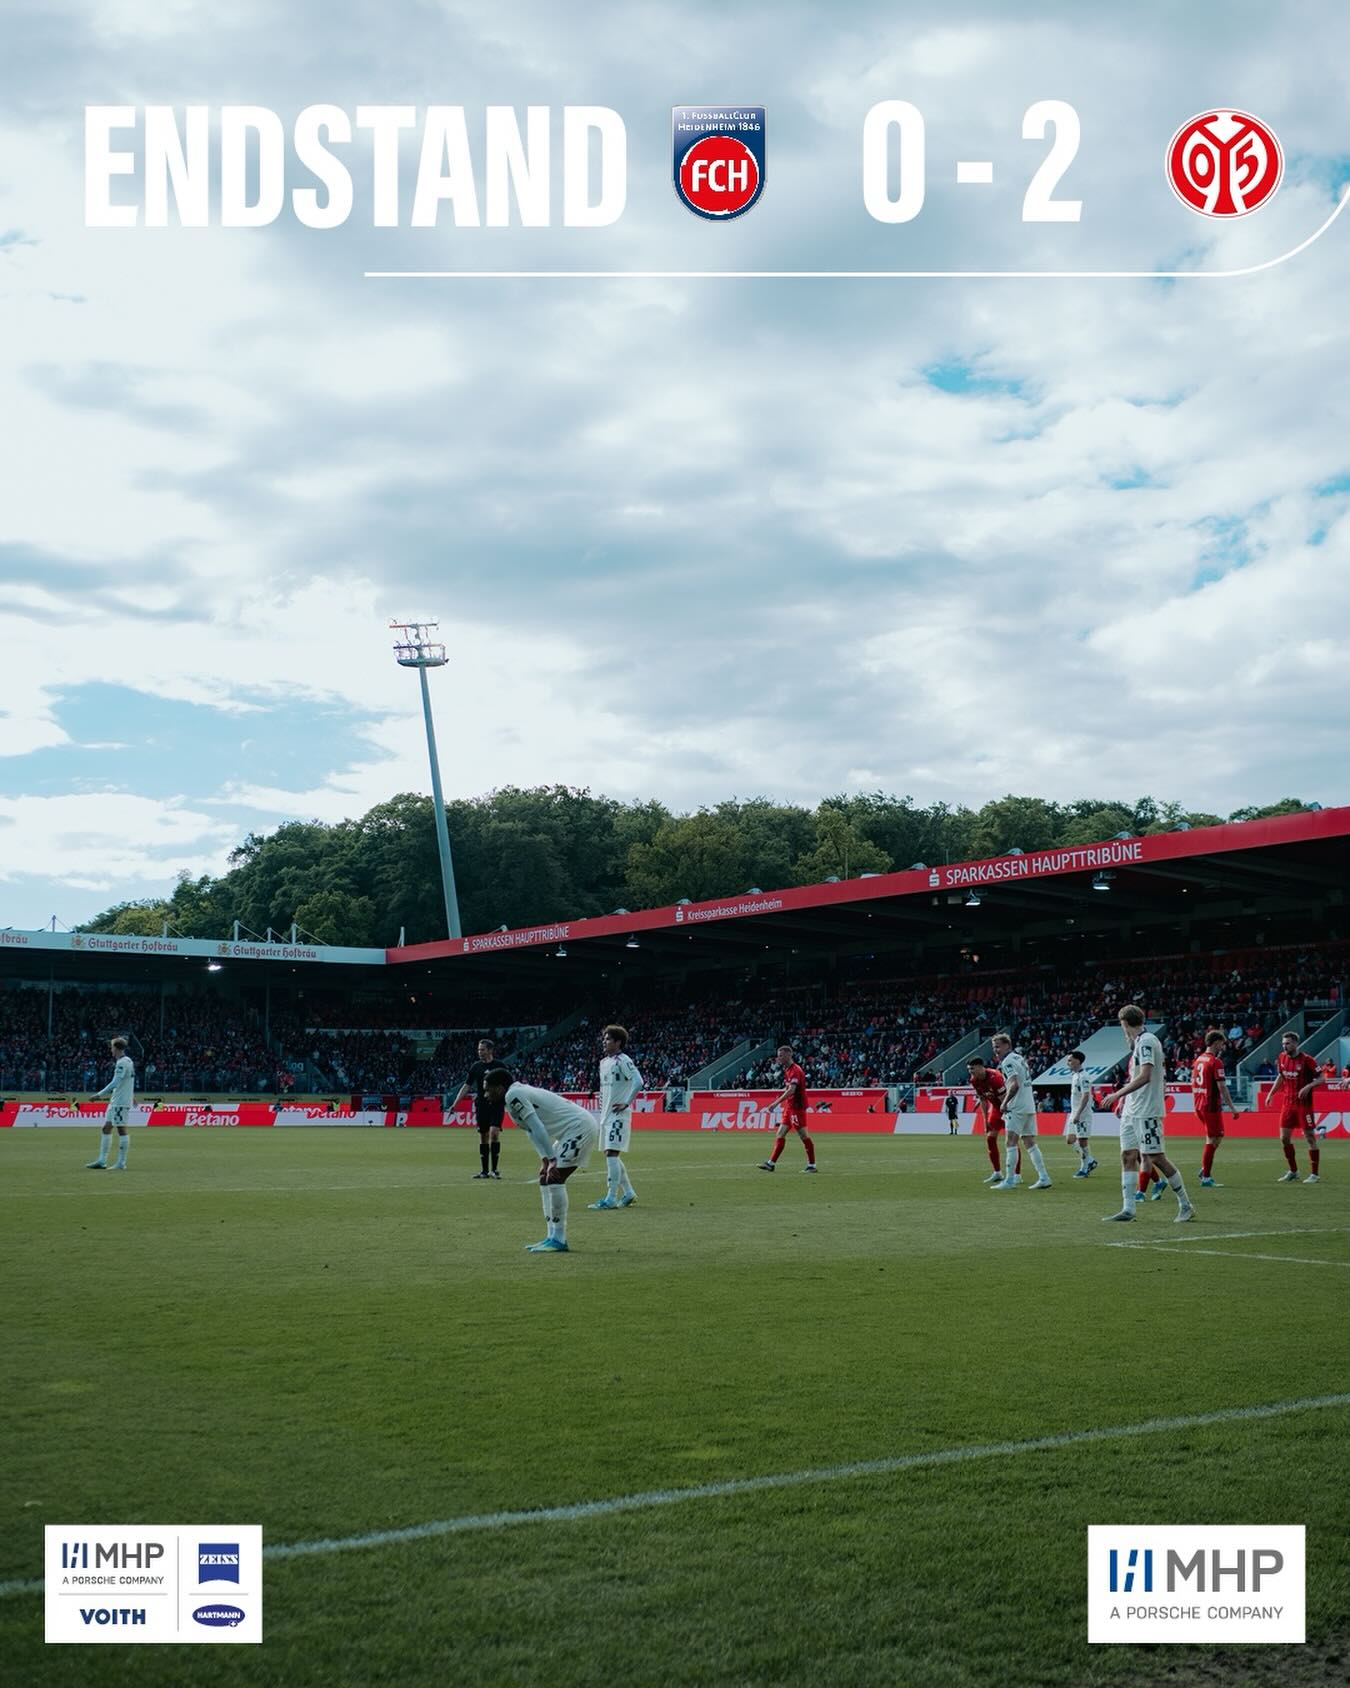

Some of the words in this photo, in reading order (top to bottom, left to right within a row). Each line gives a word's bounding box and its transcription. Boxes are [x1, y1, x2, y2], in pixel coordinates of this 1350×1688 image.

[946, 859, 1029, 885] SPARKASSEN
[1032, 842, 1143, 873] HAUPTTRIBÜNE
[687, 906, 738, 920] Kreissparkasse
[739, 898, 783, 913] Heidenheim
[88, 937, 140, 951] Stuttgarter
[141, 939, 178, 952] Hofbräu
[472, 936, 515, 950] SPARKASSEN
[516, 925, 570, 942] HAUPTTRIBÜNE
[233, 945, 281, 958] Stuttgarter
[282, 947, 317, 959] Hofbräu
[1196, 1063, 1205, 1085] 3
[184, 1112, 240, 1126] Betano
